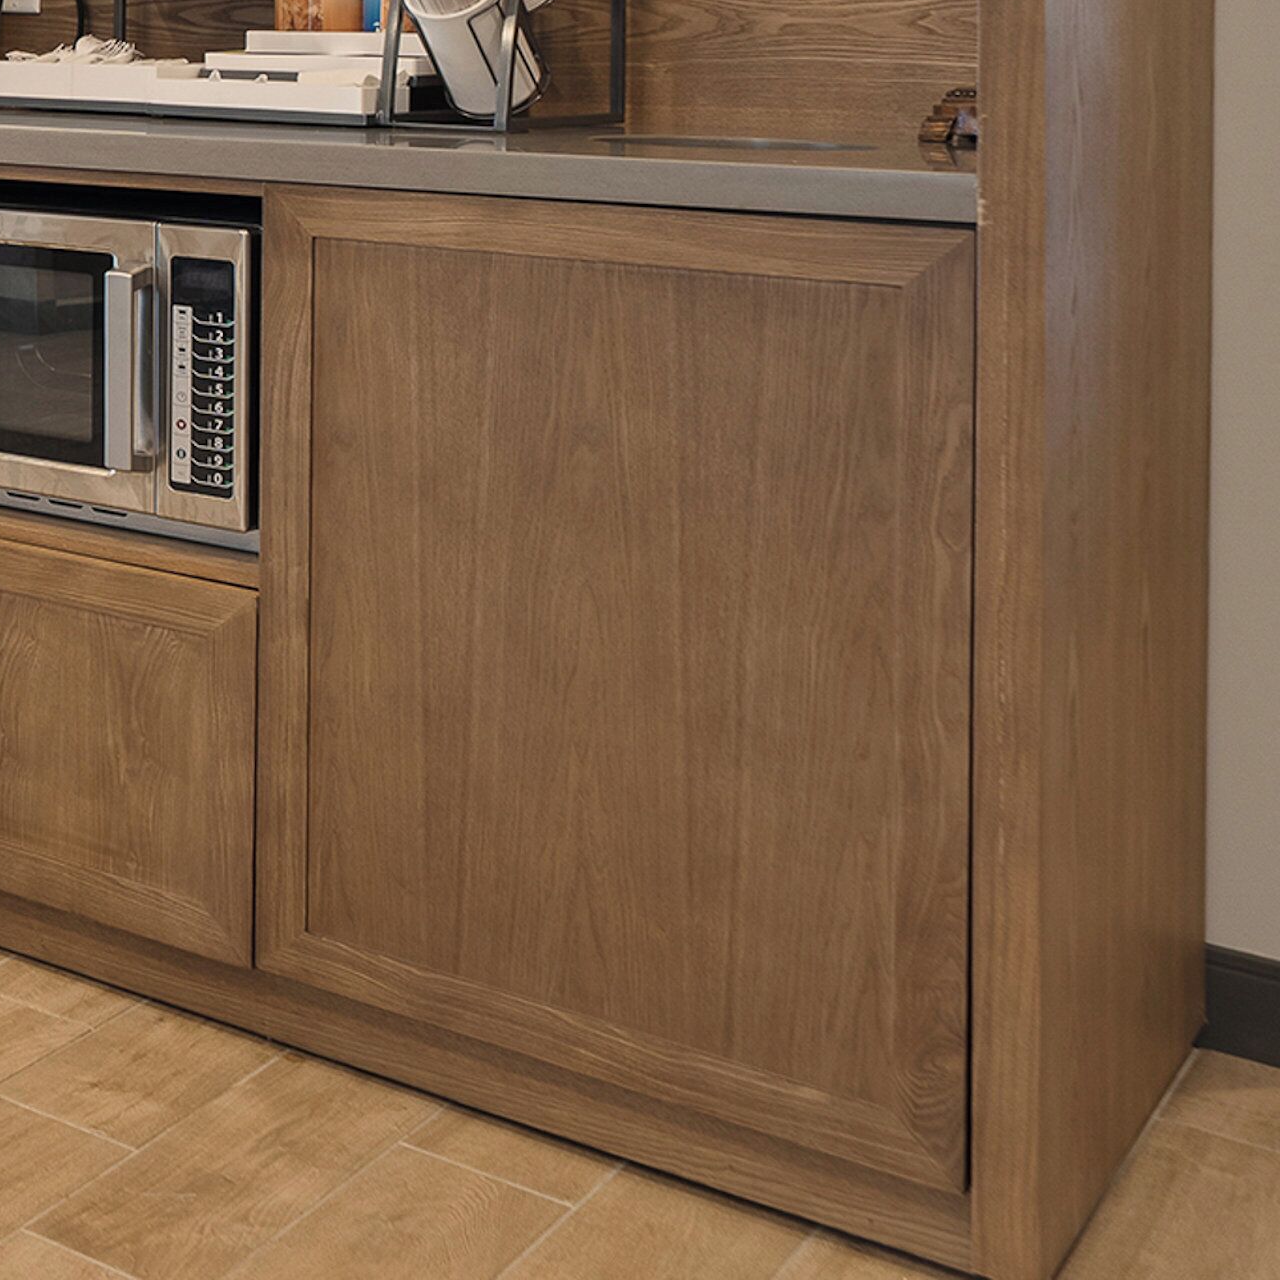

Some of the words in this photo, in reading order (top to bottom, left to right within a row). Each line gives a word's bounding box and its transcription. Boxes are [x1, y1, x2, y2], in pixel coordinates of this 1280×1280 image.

[216, 311, 223, 323] 1
[216, 330, 224, 342] 2
[215, 347, 224, 359] 3
[215, 365, 224, 377] 4
[215, 383, 224, 395] 5
[214, 401, 224, 414] 6
[214, 419, 223, 430] 7
[214, 437, 223, 449] 8
[214, 454, 224, 466] 9
[213, 472, 224, 485] 0
